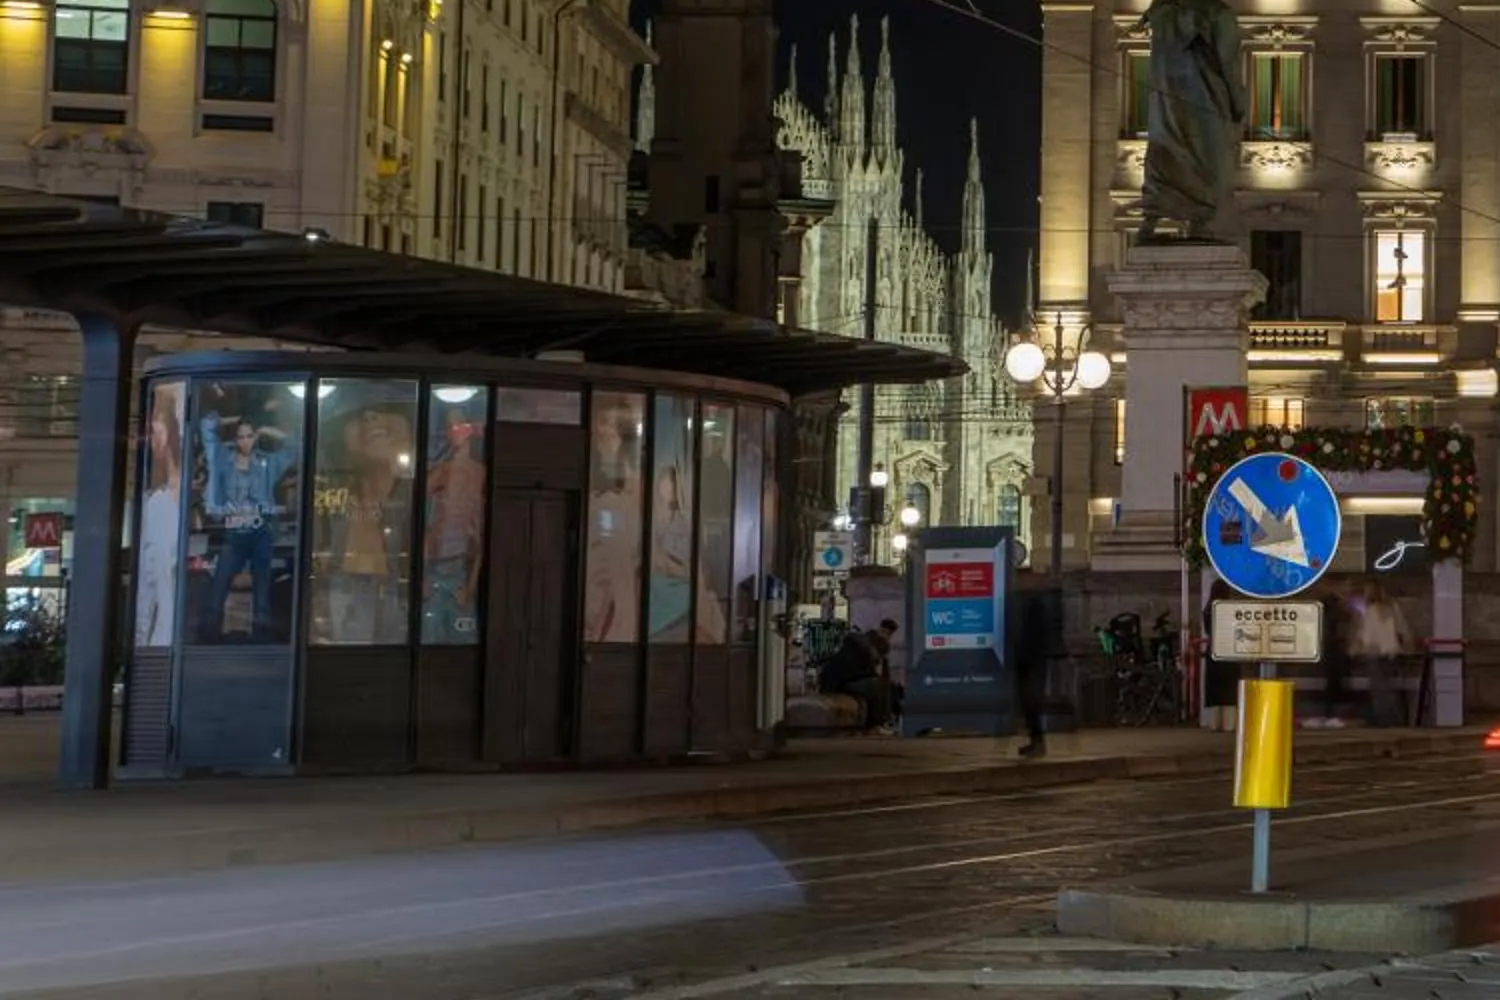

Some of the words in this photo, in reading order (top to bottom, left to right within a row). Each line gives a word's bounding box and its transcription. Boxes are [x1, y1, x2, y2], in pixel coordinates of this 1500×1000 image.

[1193, 402, 1242, 440] M
[931, 610, 954, 625] WC
[1235, 608, 1298, 621] eccetto
